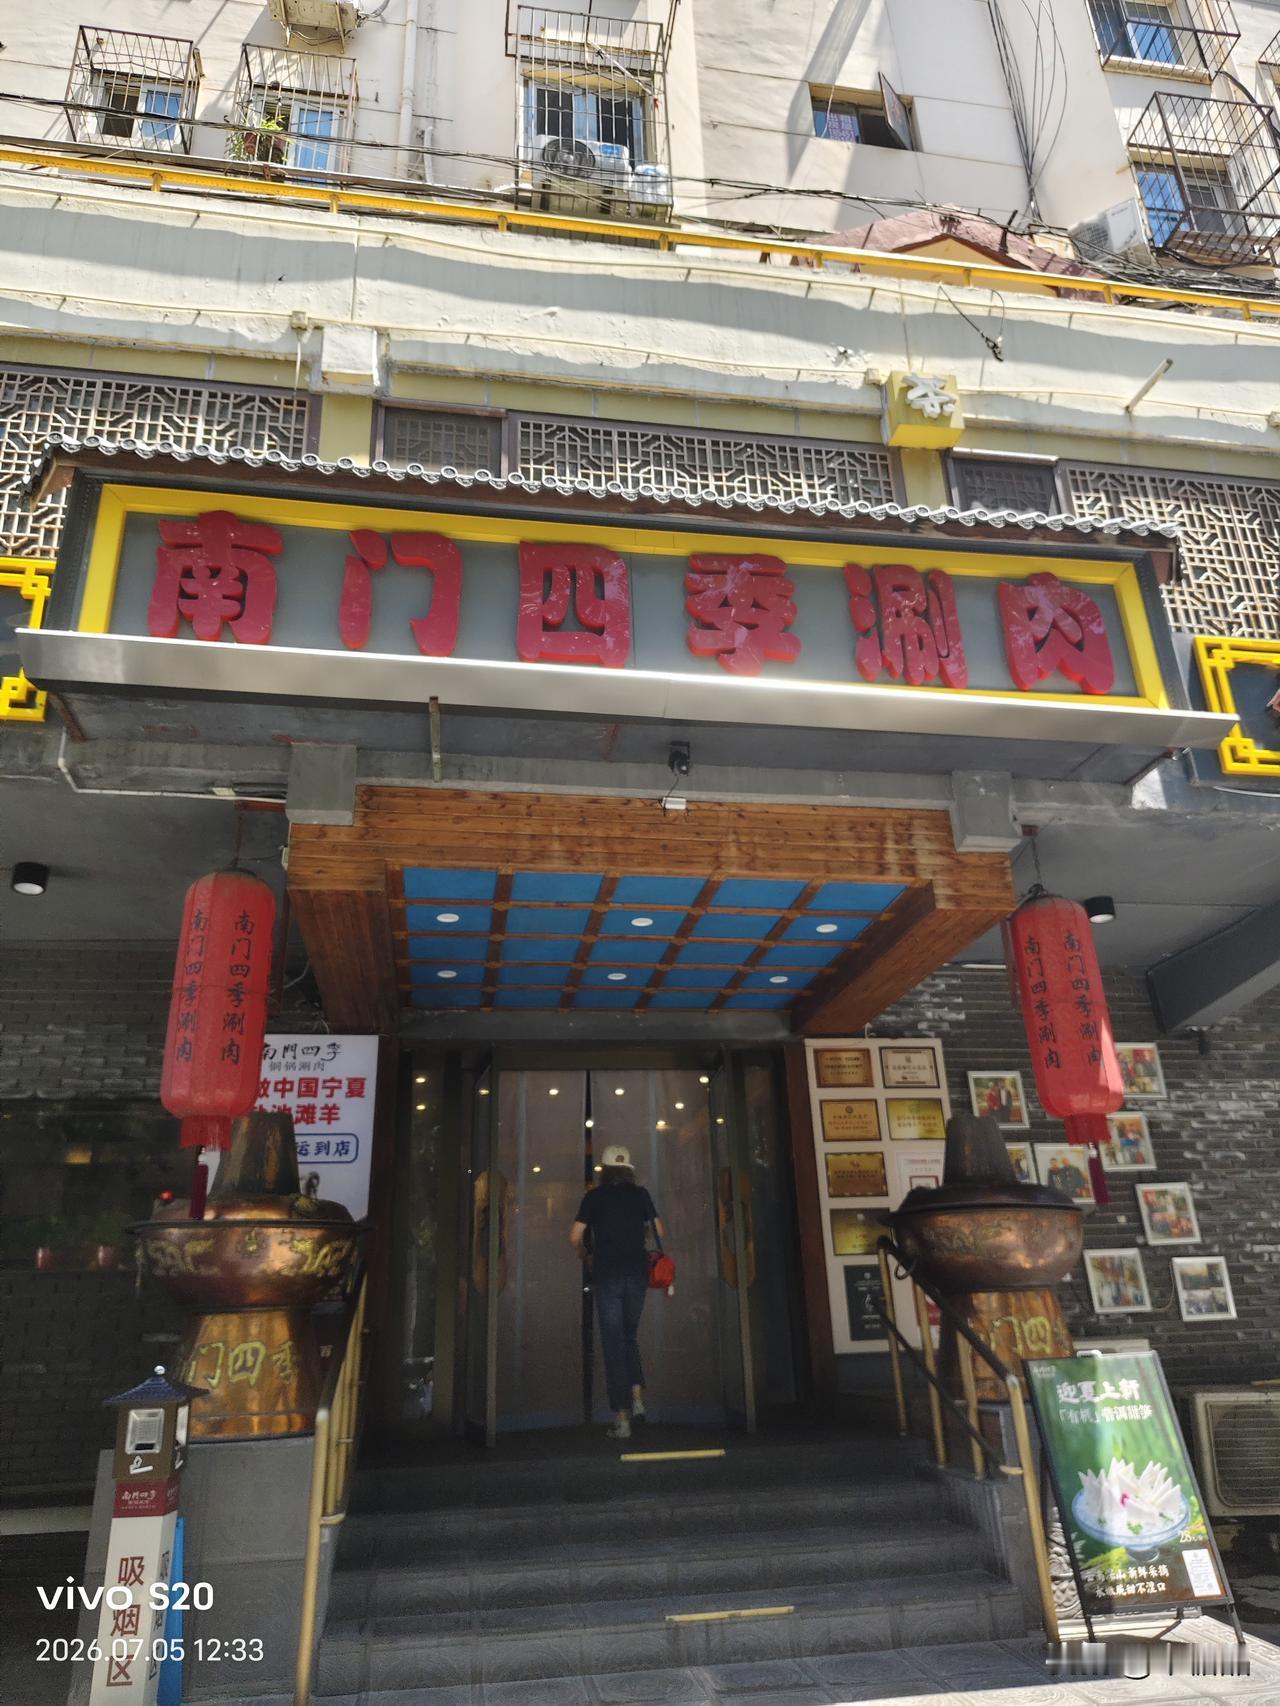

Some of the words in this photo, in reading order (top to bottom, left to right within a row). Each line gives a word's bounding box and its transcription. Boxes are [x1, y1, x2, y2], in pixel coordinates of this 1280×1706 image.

[147, 510, 1115, 695] 南门四季涮肉
[175, 908, 208, 1062] 南门四季涮肉
[221, 908, 255, 1064] 南门四季涮肉
[1025, 935, 1061, 1069] 南门四季涮肉
[1064, 930, 1102, 1067] 南门四季涮肉
[106, 1556, 145, 1687] 吸烟区
